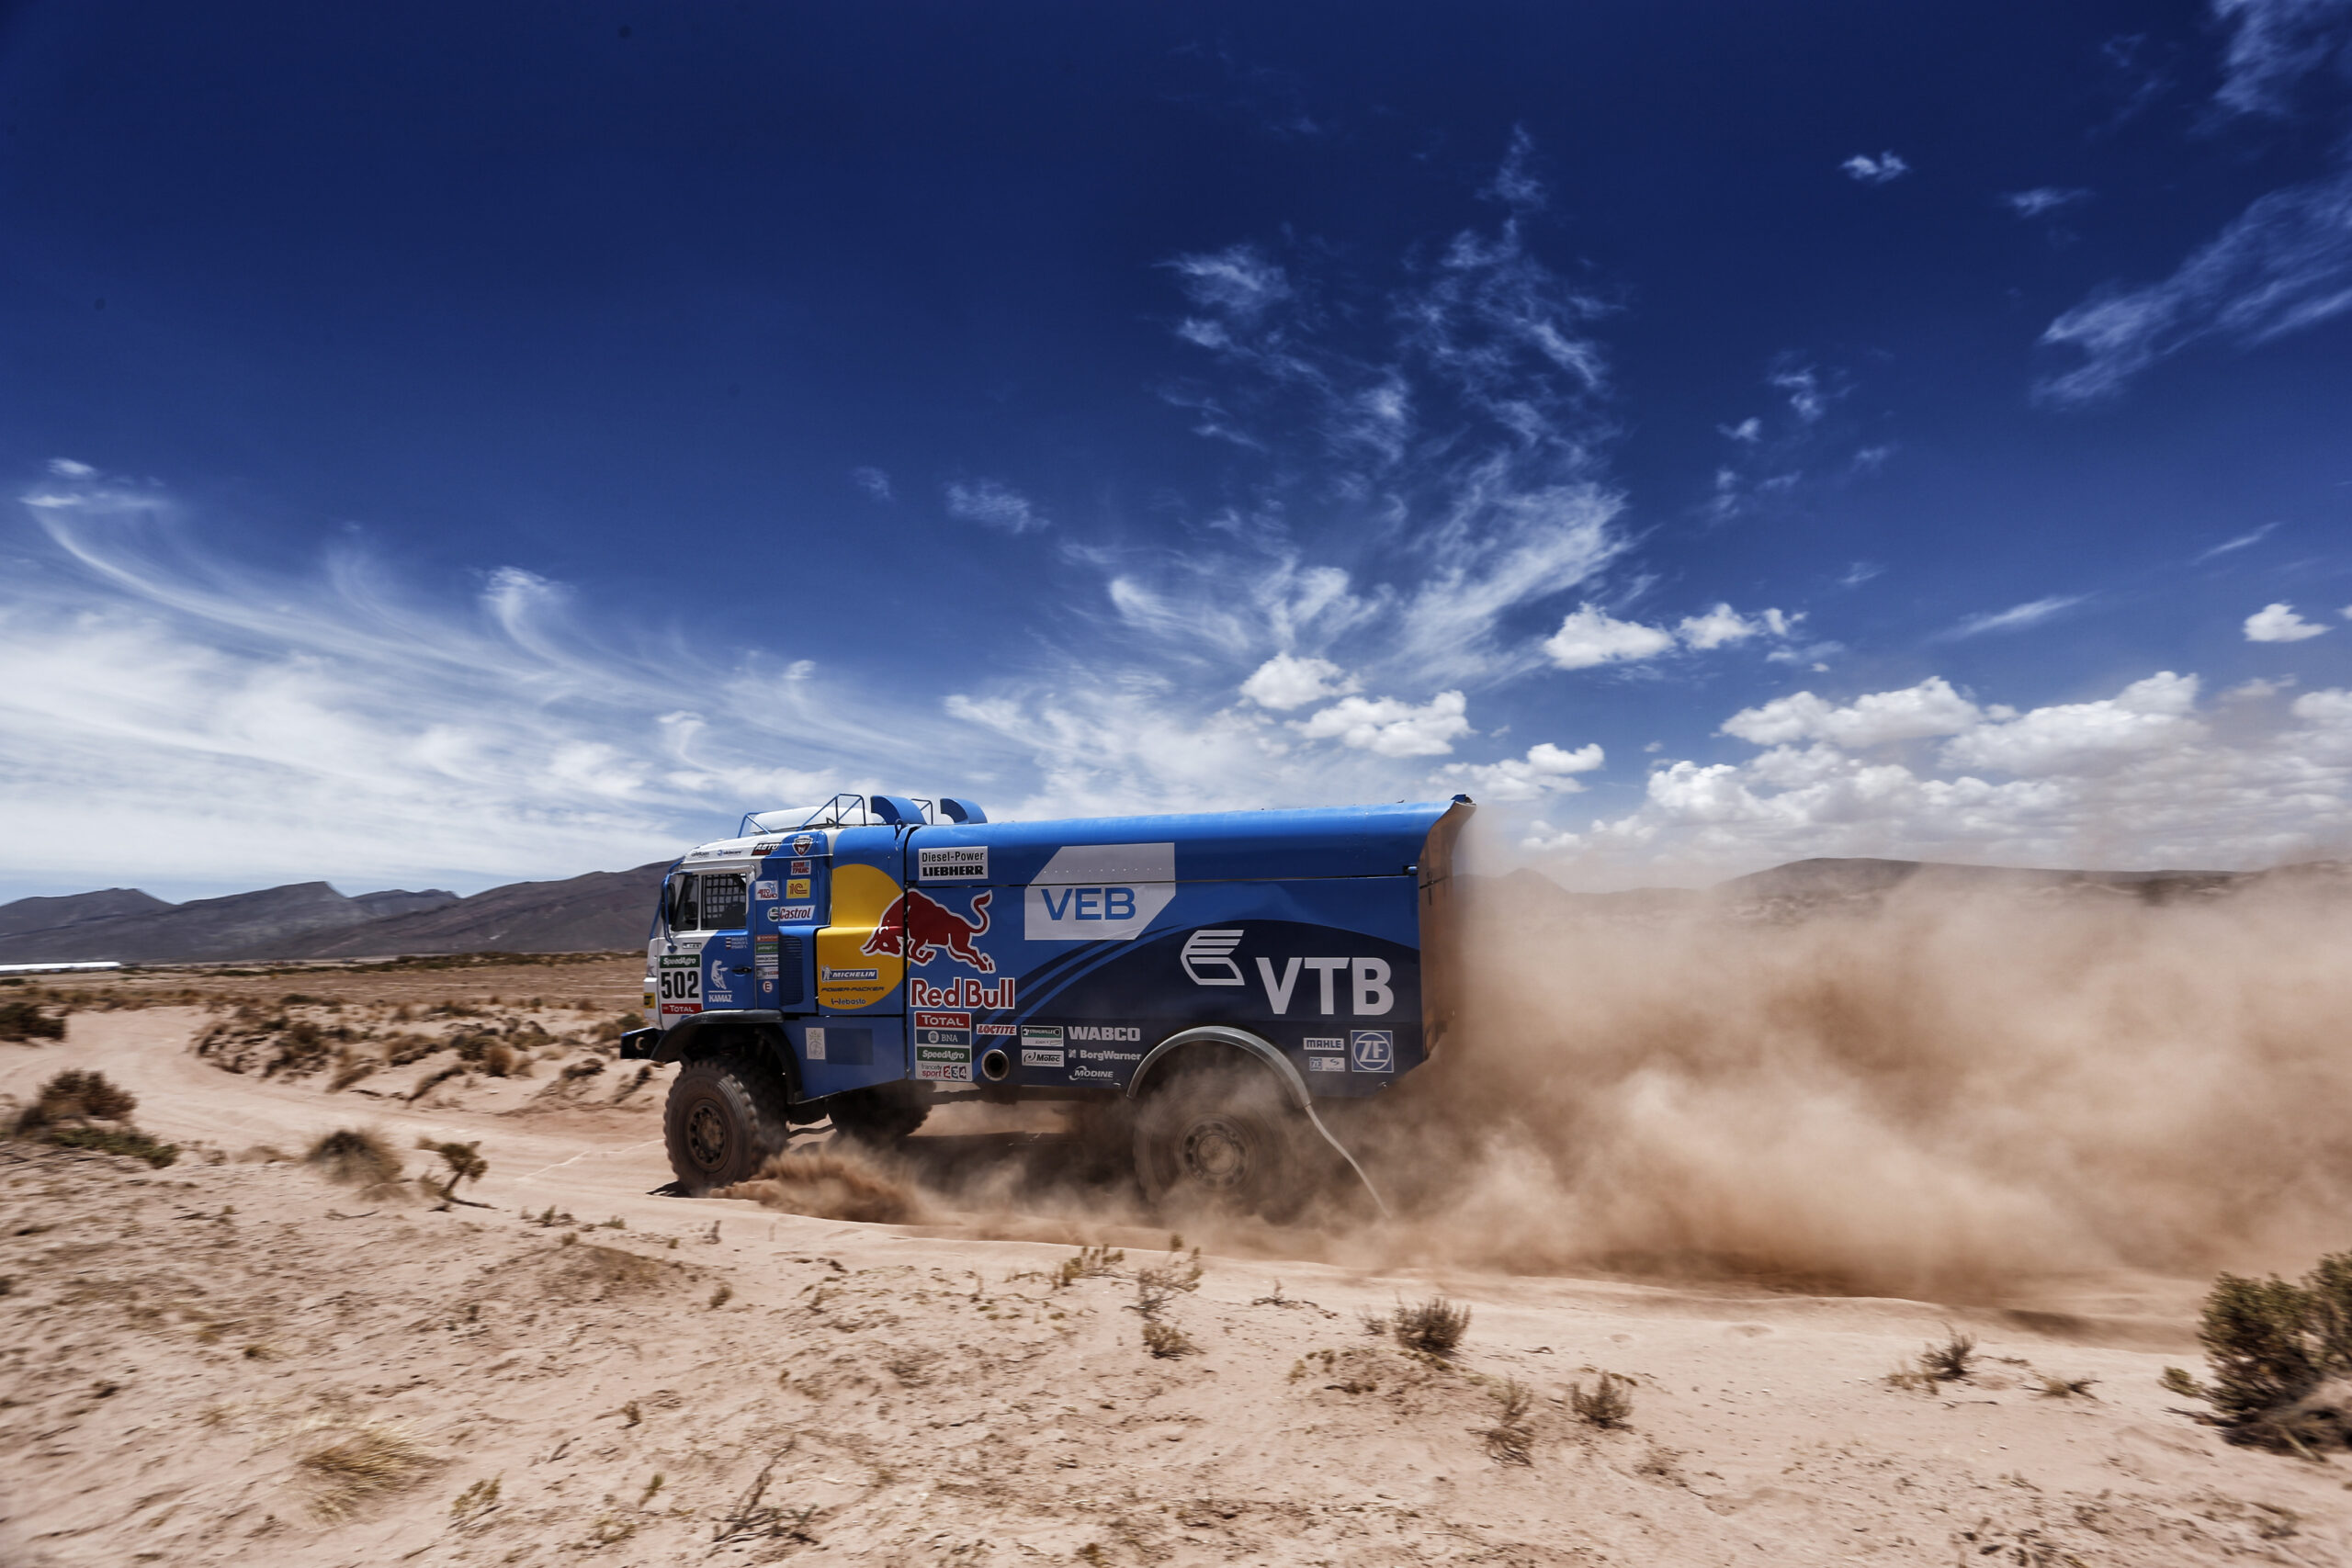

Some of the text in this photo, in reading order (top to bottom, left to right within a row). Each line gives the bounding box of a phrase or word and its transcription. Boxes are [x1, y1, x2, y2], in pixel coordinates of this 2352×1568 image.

[922, 852, 984, 862] Diesel-Power
[922, 865, 984, 877] LIEBHERR
[1041, 886, 1136, 921] VEB
[779, 908, 811, 919] Castrol
[661, 971, 700, 999] 502
[1255, 957, 1395, 1016] VTB
[708, 994, 732, 1003] KAMAZ
[910, 977, 1015, 1010] Red Bull
[669, 1005, 694, 1013] TOTAL
[922, 1014, 964, 1026] TOTAL
[978, 1025, 1015, 1034] LOCTITE
[1068, 1026, 1141, 1042] WABCO
[941, 1034, 958, 1043] BNA
[1306, 1040, 1341, 1048] MAHLE
[922, 1050, 965, 1061] SpeedAgro
[1080, 1050, 1141, 1061] BorgWarner
[1074, 1069, 1114, 1078] MODINE
